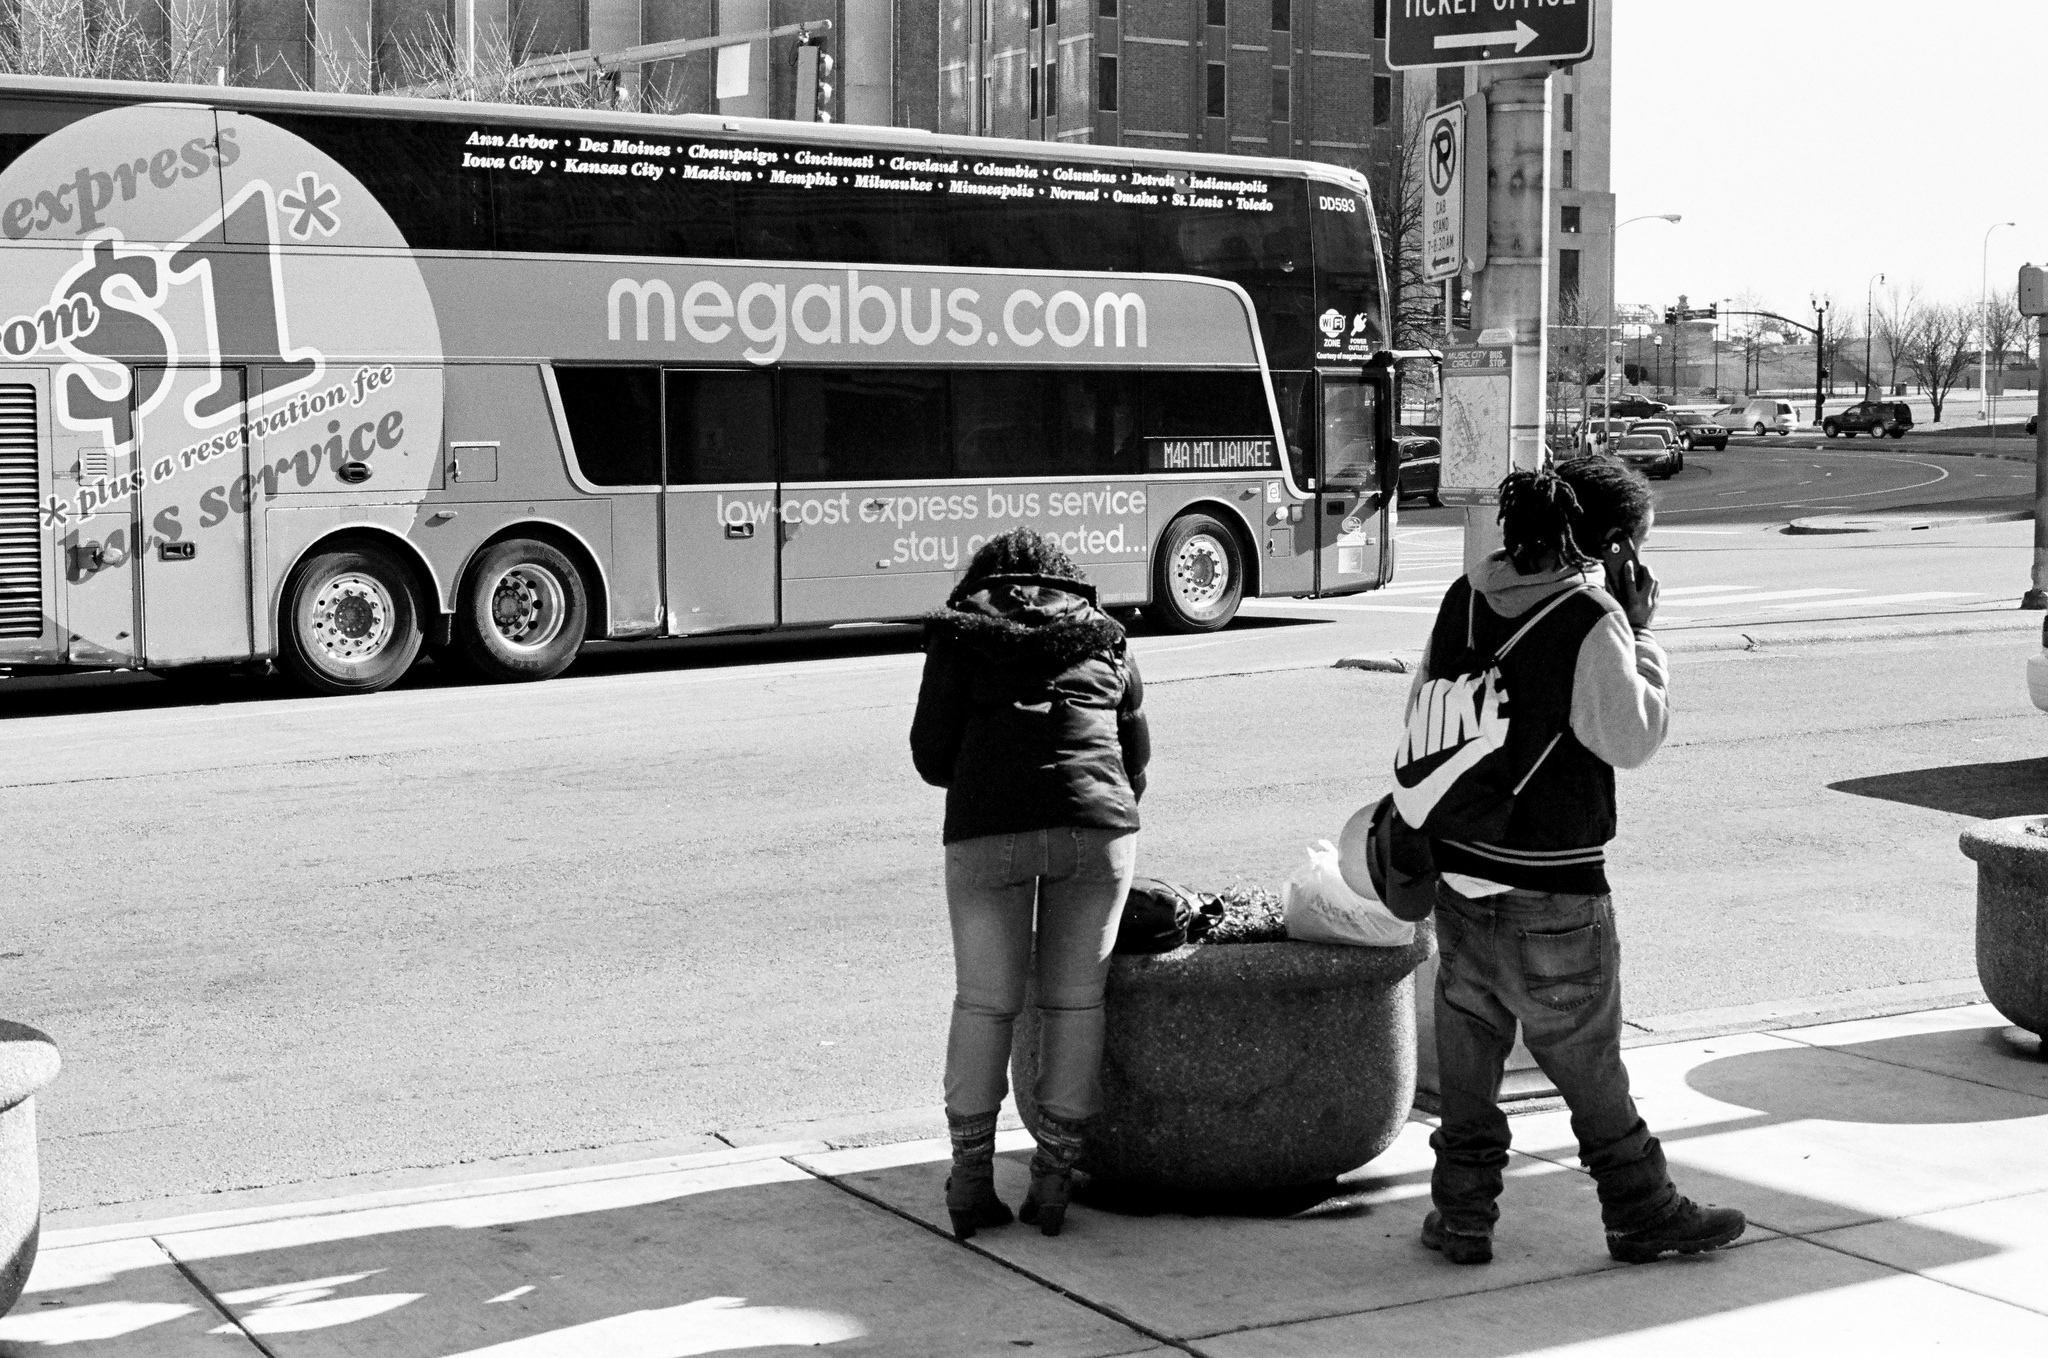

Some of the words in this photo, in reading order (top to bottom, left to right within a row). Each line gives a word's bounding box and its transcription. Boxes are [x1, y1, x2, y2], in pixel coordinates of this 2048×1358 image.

[466, 131, 504, 146] Ann
[506, 133, 559, 150] Arbor
[578, 137, 609, 153] Des
[612, 139, 671, 157] Moines
[688, 144, 778, 166] Champaign
[794, 150, 874, 169] Cincinnati
[889, 156, 959, 174] Cleveland
[973, 162, 1038, 179] Columbia
[1052, 167, 1117, 184] Columbus
[1131, 172, 1176, 188] Detroit
[1189, 176, 1268, 195] Indianapolis
[1, 127, 241, 240] express
[462, 152, 506, 169] Iowa
[509, 154, 544, 174] City
[564, 158, 628, 175] Kansas
[631, 161, 664, 181] City
[683, 164, 753, 182] Madison
[769, 169, 838, 189] Memphis
[854, 174, 932, 192] Milwaukee
[949, 179, 1035, 200] Minneapolis
[1050, 185, 1099, 202] Normal
[1113, 189, 1159, 205] Omaha
[1236, 197, 1273, 212] Toledo
[1319, 195, 1356, 213] DD593
[1436, 199, 1447, 215] CAB
[1433, 216, 1449, 235] STAND
[0, 294, 98, 357] om
[607, 270, 1147, 366] megabus.com
[1323, 338, 1341, 347] ZONE
[1447, 351, 1471, 360] MUSIC
[1471, 350, 1487, 359] CITY
[1489, 350, 1503, 359] BUS
[1451, 360, 1480, 368] CIRCUIT
[1489, 359, 1507, 368] STOP
[152, 457, 174, 480] a
[180, 386, 347, 469] reservation
[352, 364, 394, 406] fee
[199, 410, 404, 529] service
[1164, 441, 1190, 468] M4A
[1193, 440, 1272, 468] MILWAUKEE
[716, 493, 850, 526] low-cost
[858, 492, 982, 529] express
[986, 488, 1041, 518] bus
[1048, 485, 1146, 517] service
[893, 531, 960, 568] stay
[967, 523, 1147, 557] cected...
